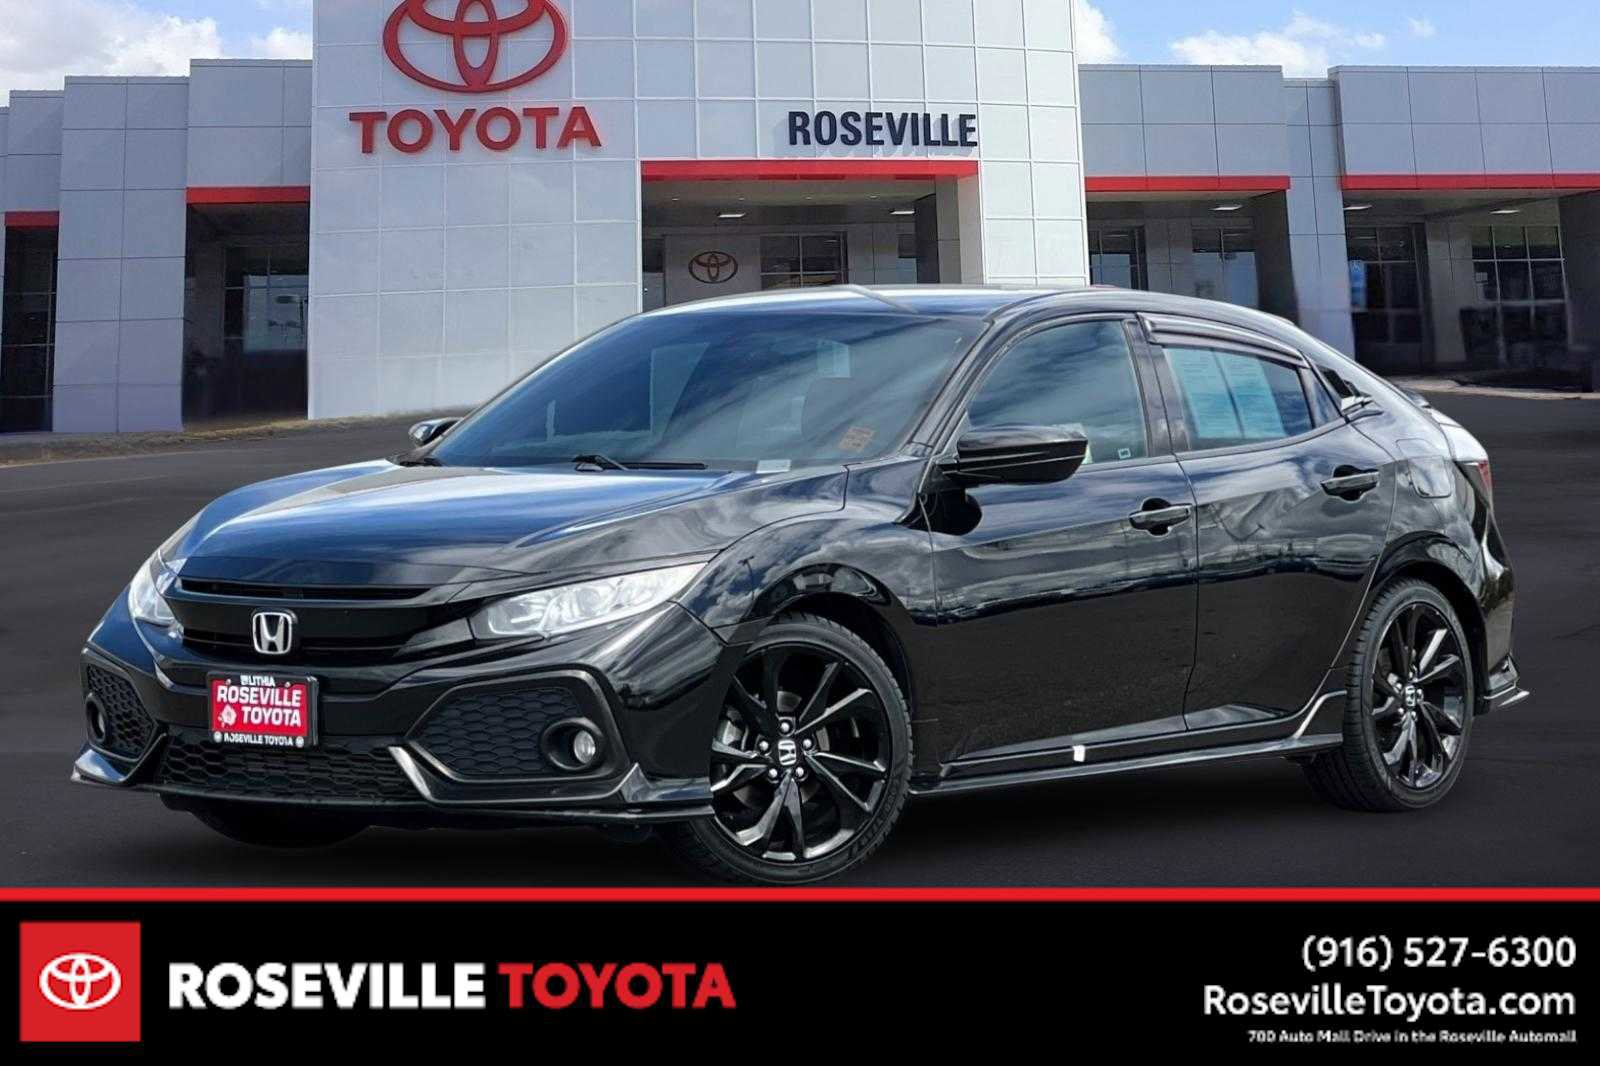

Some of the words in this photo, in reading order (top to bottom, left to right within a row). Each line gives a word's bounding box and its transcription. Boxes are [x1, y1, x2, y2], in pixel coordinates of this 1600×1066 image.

[350, 106, 602, 154] TOYOTA
[789, 111, 978, 147] ROSEVILLE
[217, 685, 302, 707] ROSEVILLE
[241, 706, 302, 727] TOYOTA
[265, 735, 294, 746] TOYOTA
